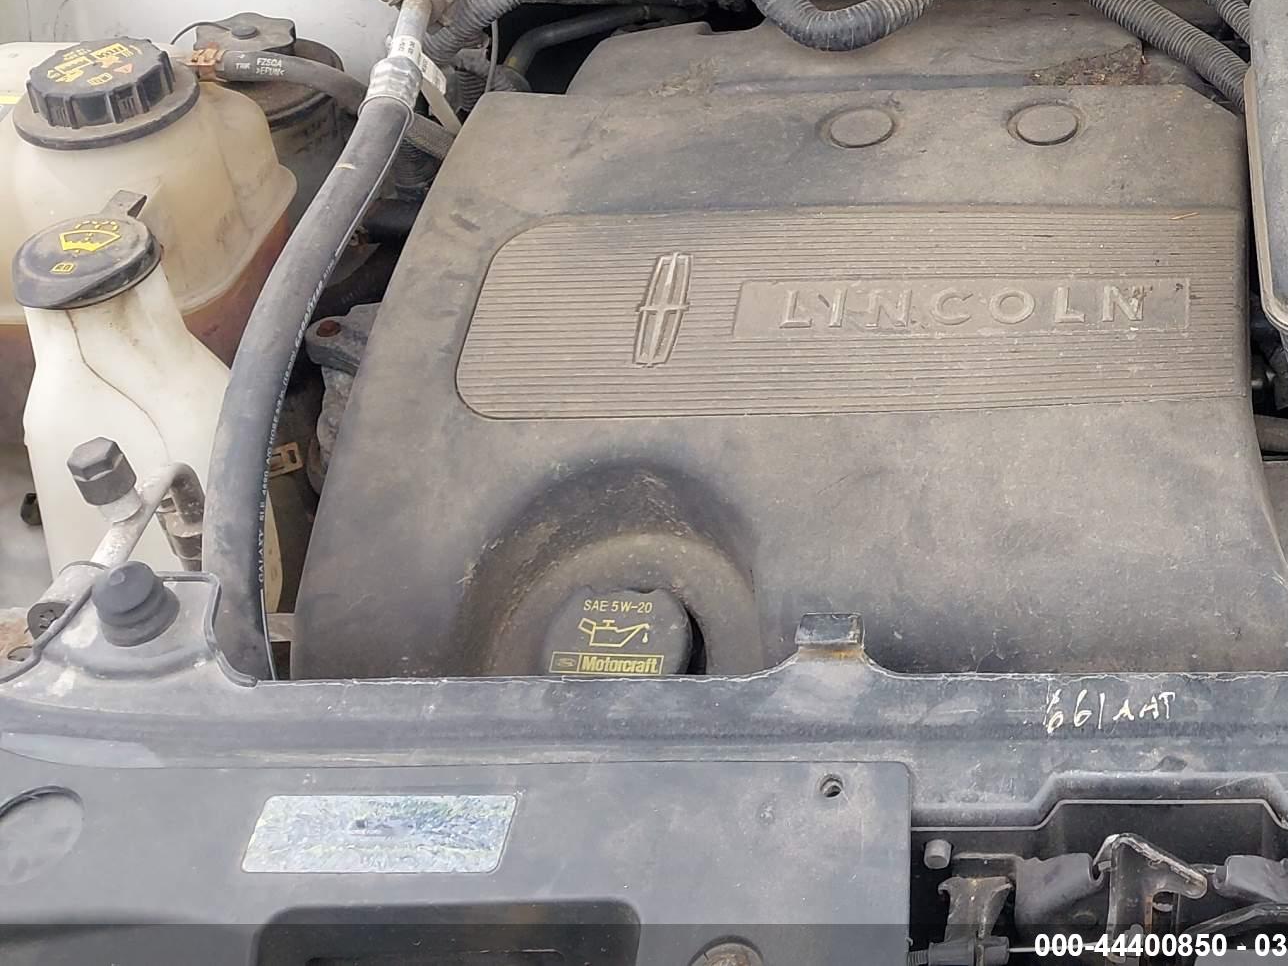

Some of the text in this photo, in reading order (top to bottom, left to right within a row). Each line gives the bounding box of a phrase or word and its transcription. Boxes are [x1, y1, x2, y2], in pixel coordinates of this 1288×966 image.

[778, 285, 1146, 329] LINCOLN
[583, 598, 654, 614] SAE 5W-20
[581, 655, 658, 674] Motorcraft
